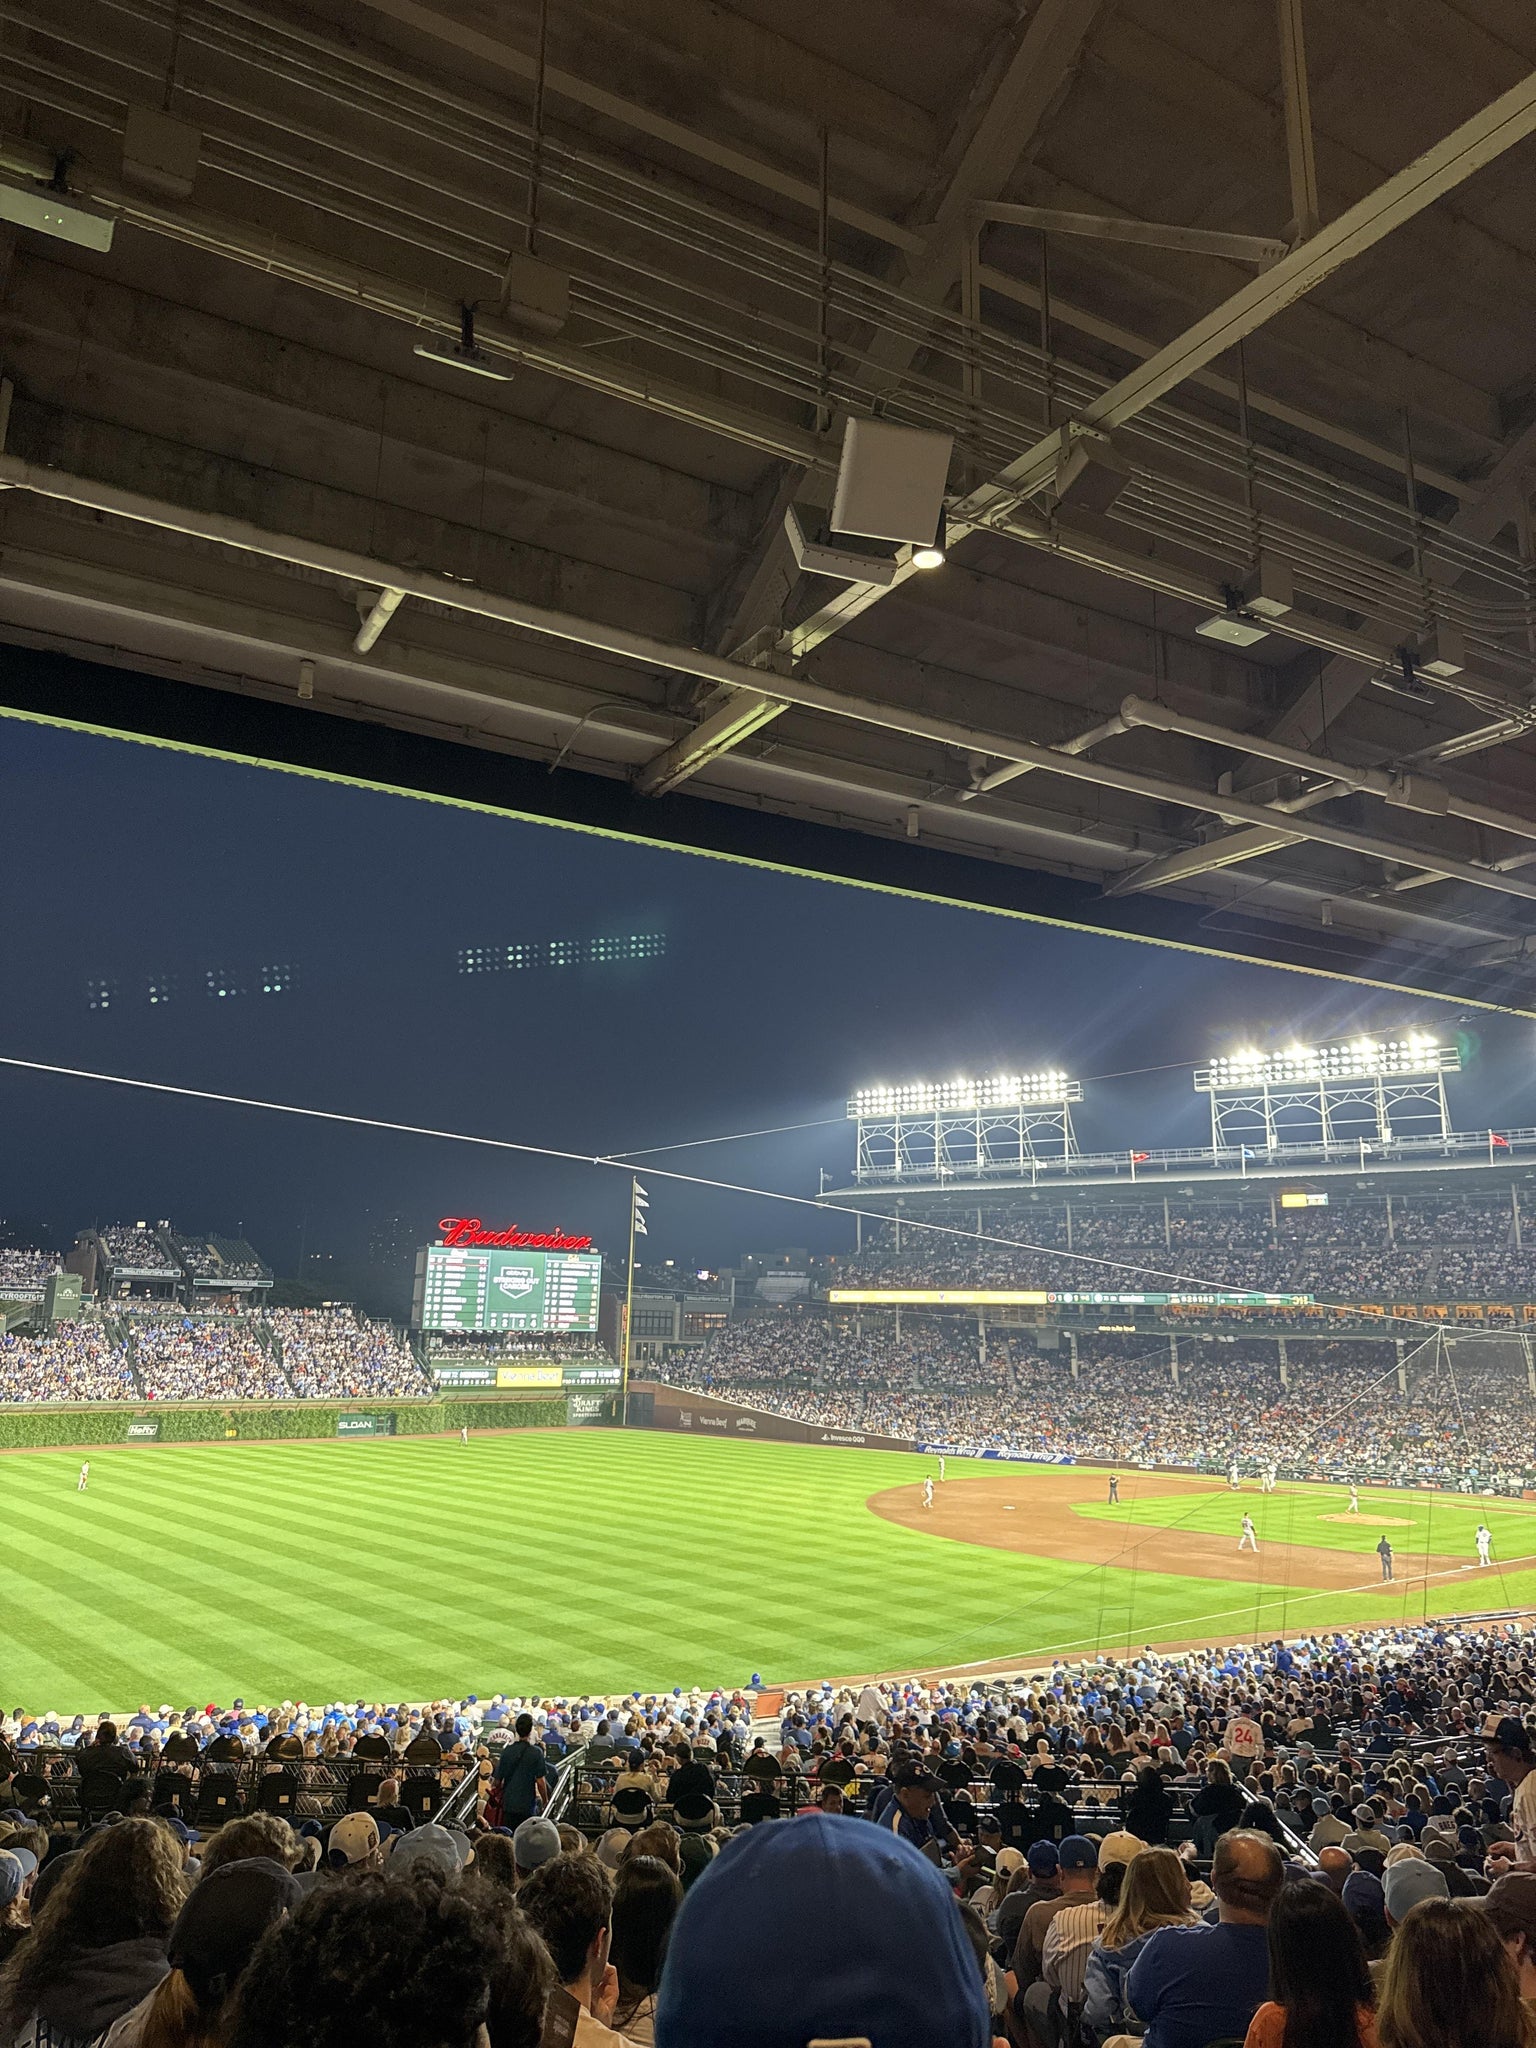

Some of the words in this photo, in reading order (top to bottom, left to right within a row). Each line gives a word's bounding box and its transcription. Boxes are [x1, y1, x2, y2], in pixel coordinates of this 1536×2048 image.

[438, 1218, 592, 1249] Budweiser
[130, 1425, 156, 1435] Hefty
[830, 1434, 852, 1442] Invesco
[924, 1445, 956, 1455] Reynolds
[956, 1447, 976, 1457] Wrap
[997, 1450, 1032, 1460] Reynolds
[1032, 1452, 1054, 1462] Wrap
[1235, 1728, 1253, 1744] 24
